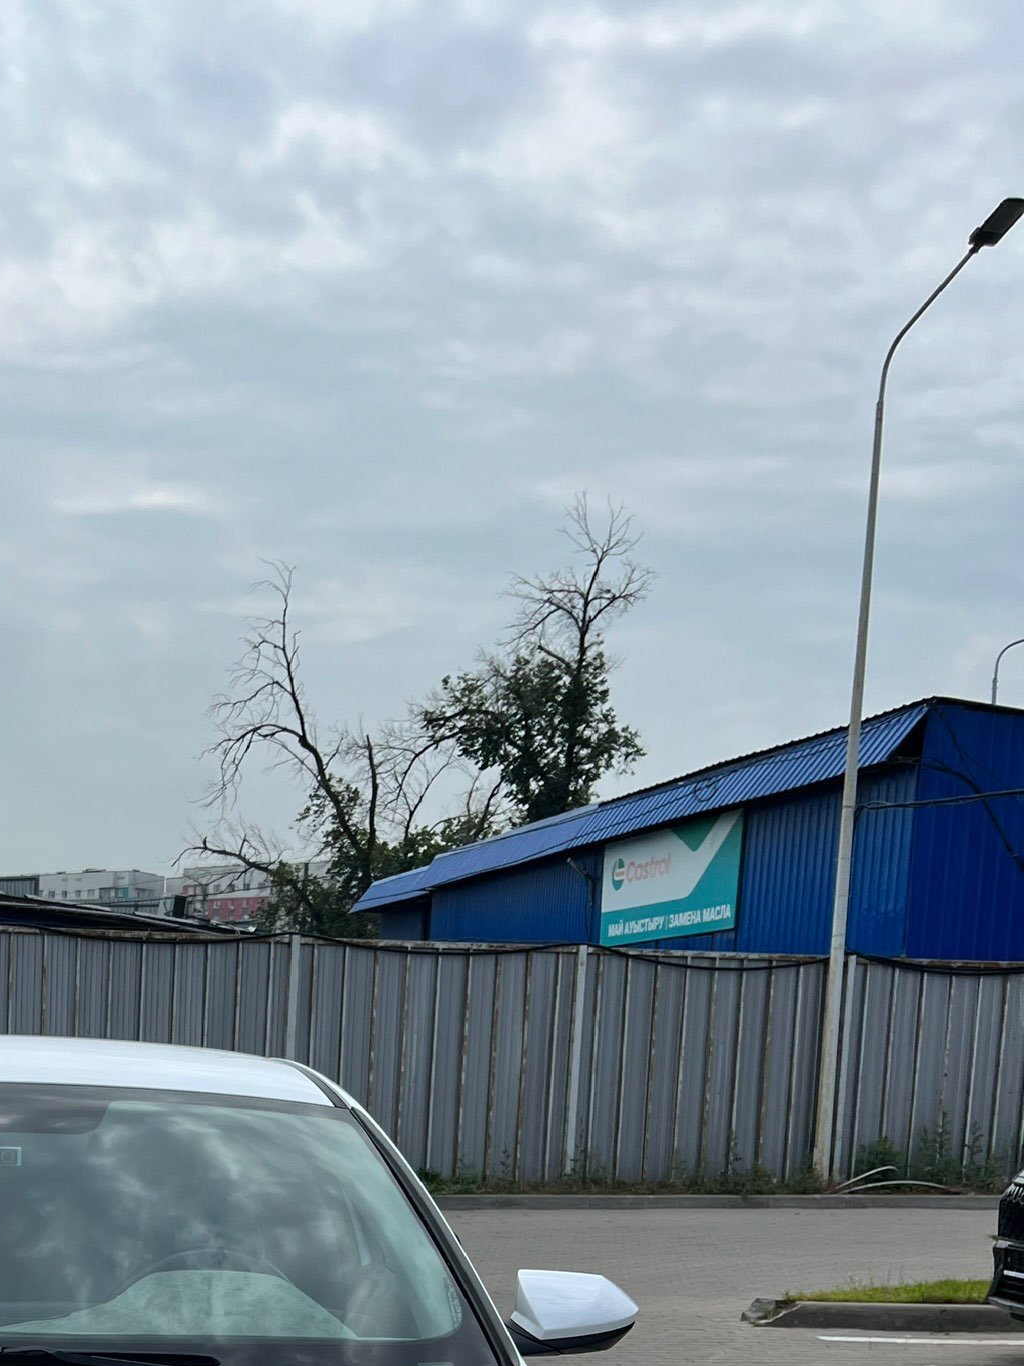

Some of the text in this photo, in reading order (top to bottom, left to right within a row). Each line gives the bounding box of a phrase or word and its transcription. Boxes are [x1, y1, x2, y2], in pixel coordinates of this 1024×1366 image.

[626, 851, 671, 883] Castrol
[608, 920, 624, 937] МАЙ
[669, 910, 701, 928] ЗАМЕНА
[703, 904, 731, 922] МАСЛА
